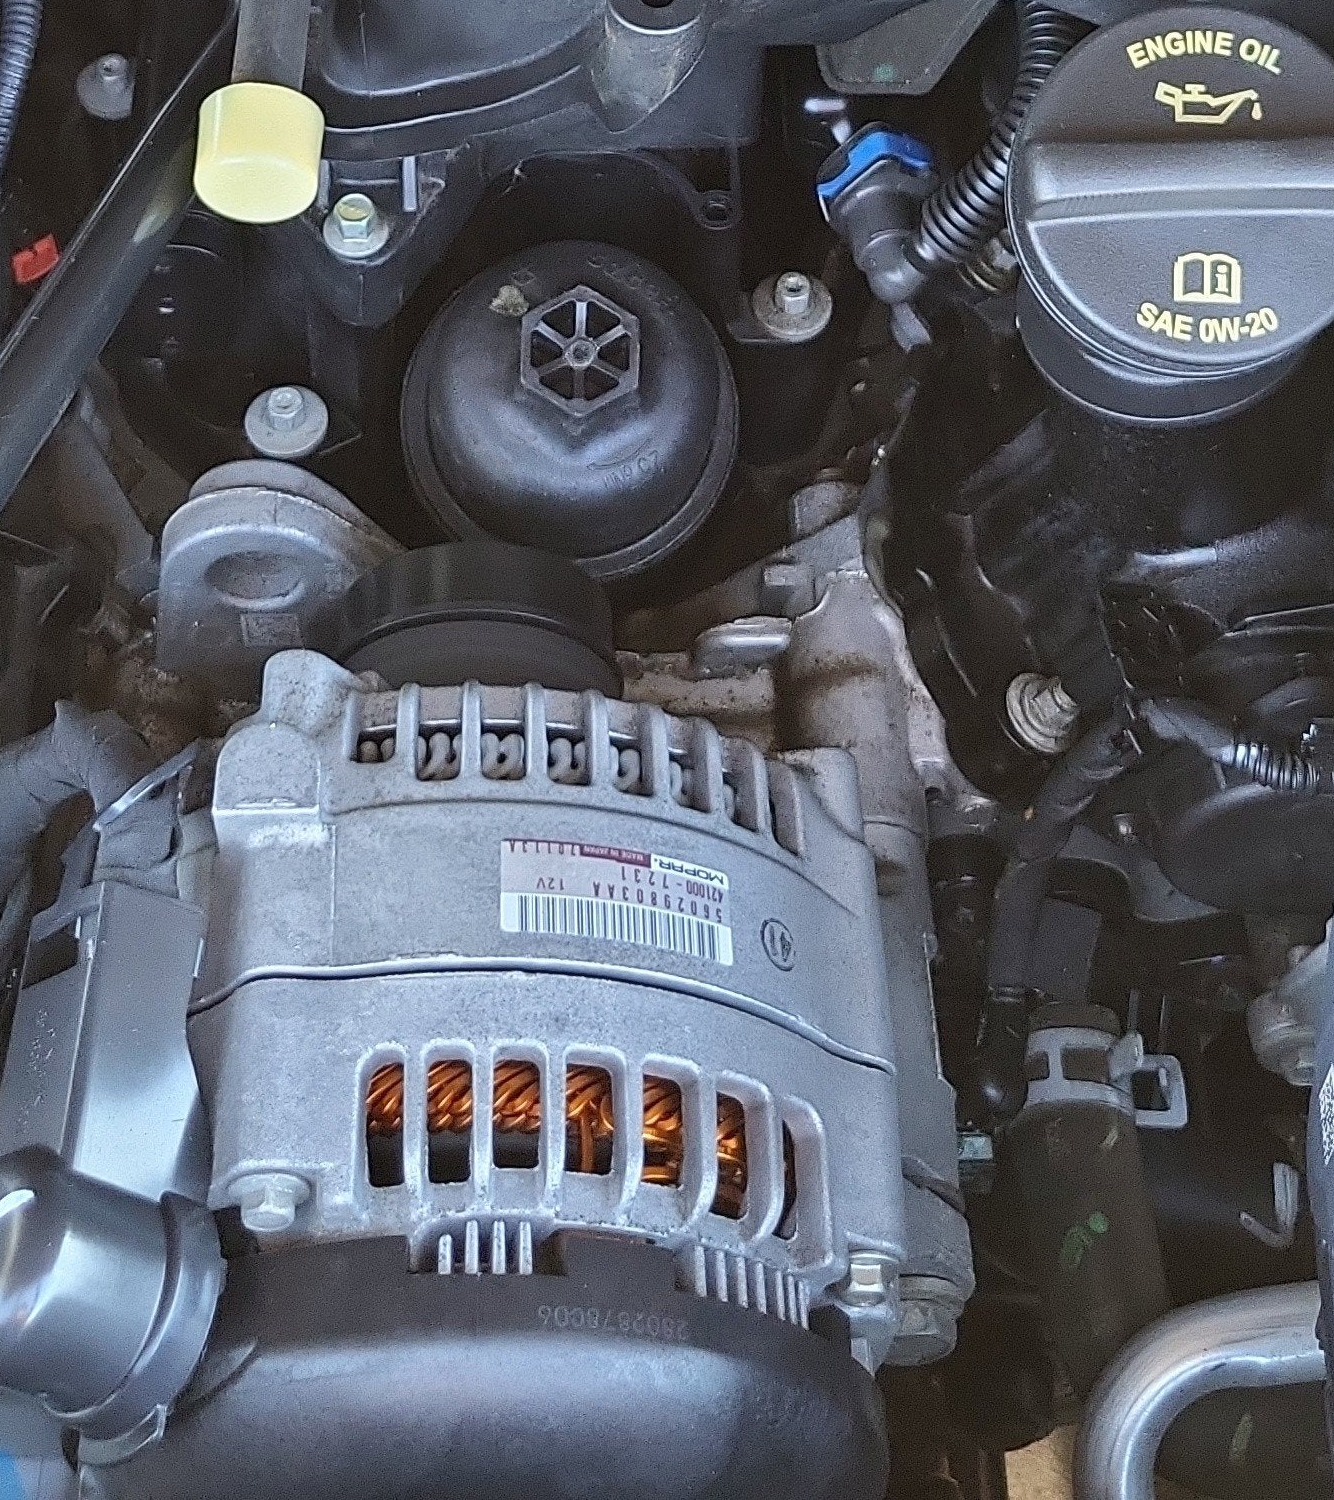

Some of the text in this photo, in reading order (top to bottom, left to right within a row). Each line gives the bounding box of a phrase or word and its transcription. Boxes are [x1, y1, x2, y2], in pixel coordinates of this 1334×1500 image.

[1125, 30, 1284, 75] ENGINE OIL
[1135, 302, 1279, 343] SAE 0W-20
[583, 844, 644, 861] MADE IN JAPAN
[536, 877, 722, 924] 56029803AA 12V
